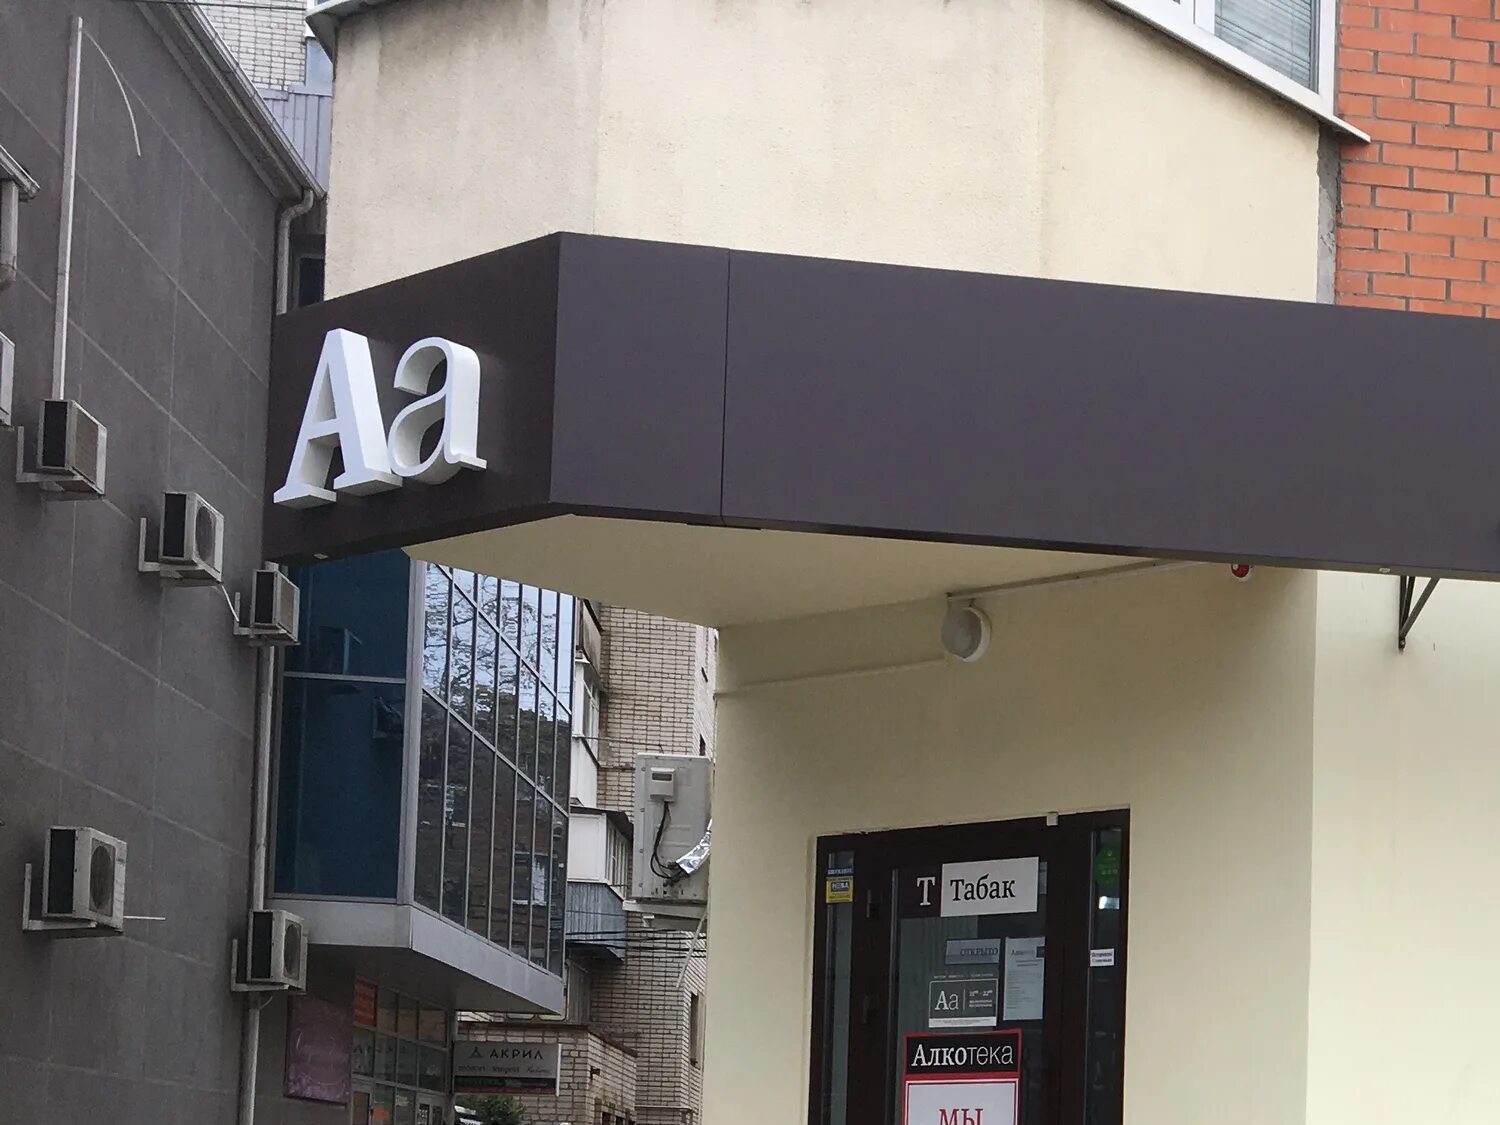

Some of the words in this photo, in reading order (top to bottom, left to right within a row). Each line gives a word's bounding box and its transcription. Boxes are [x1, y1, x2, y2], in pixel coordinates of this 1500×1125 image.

[950, 873, 1016, 902] Табак
[489, 1048, 544, 1060] АКРИЛ
[911, 1043, 1014, 1066] Алкотека
